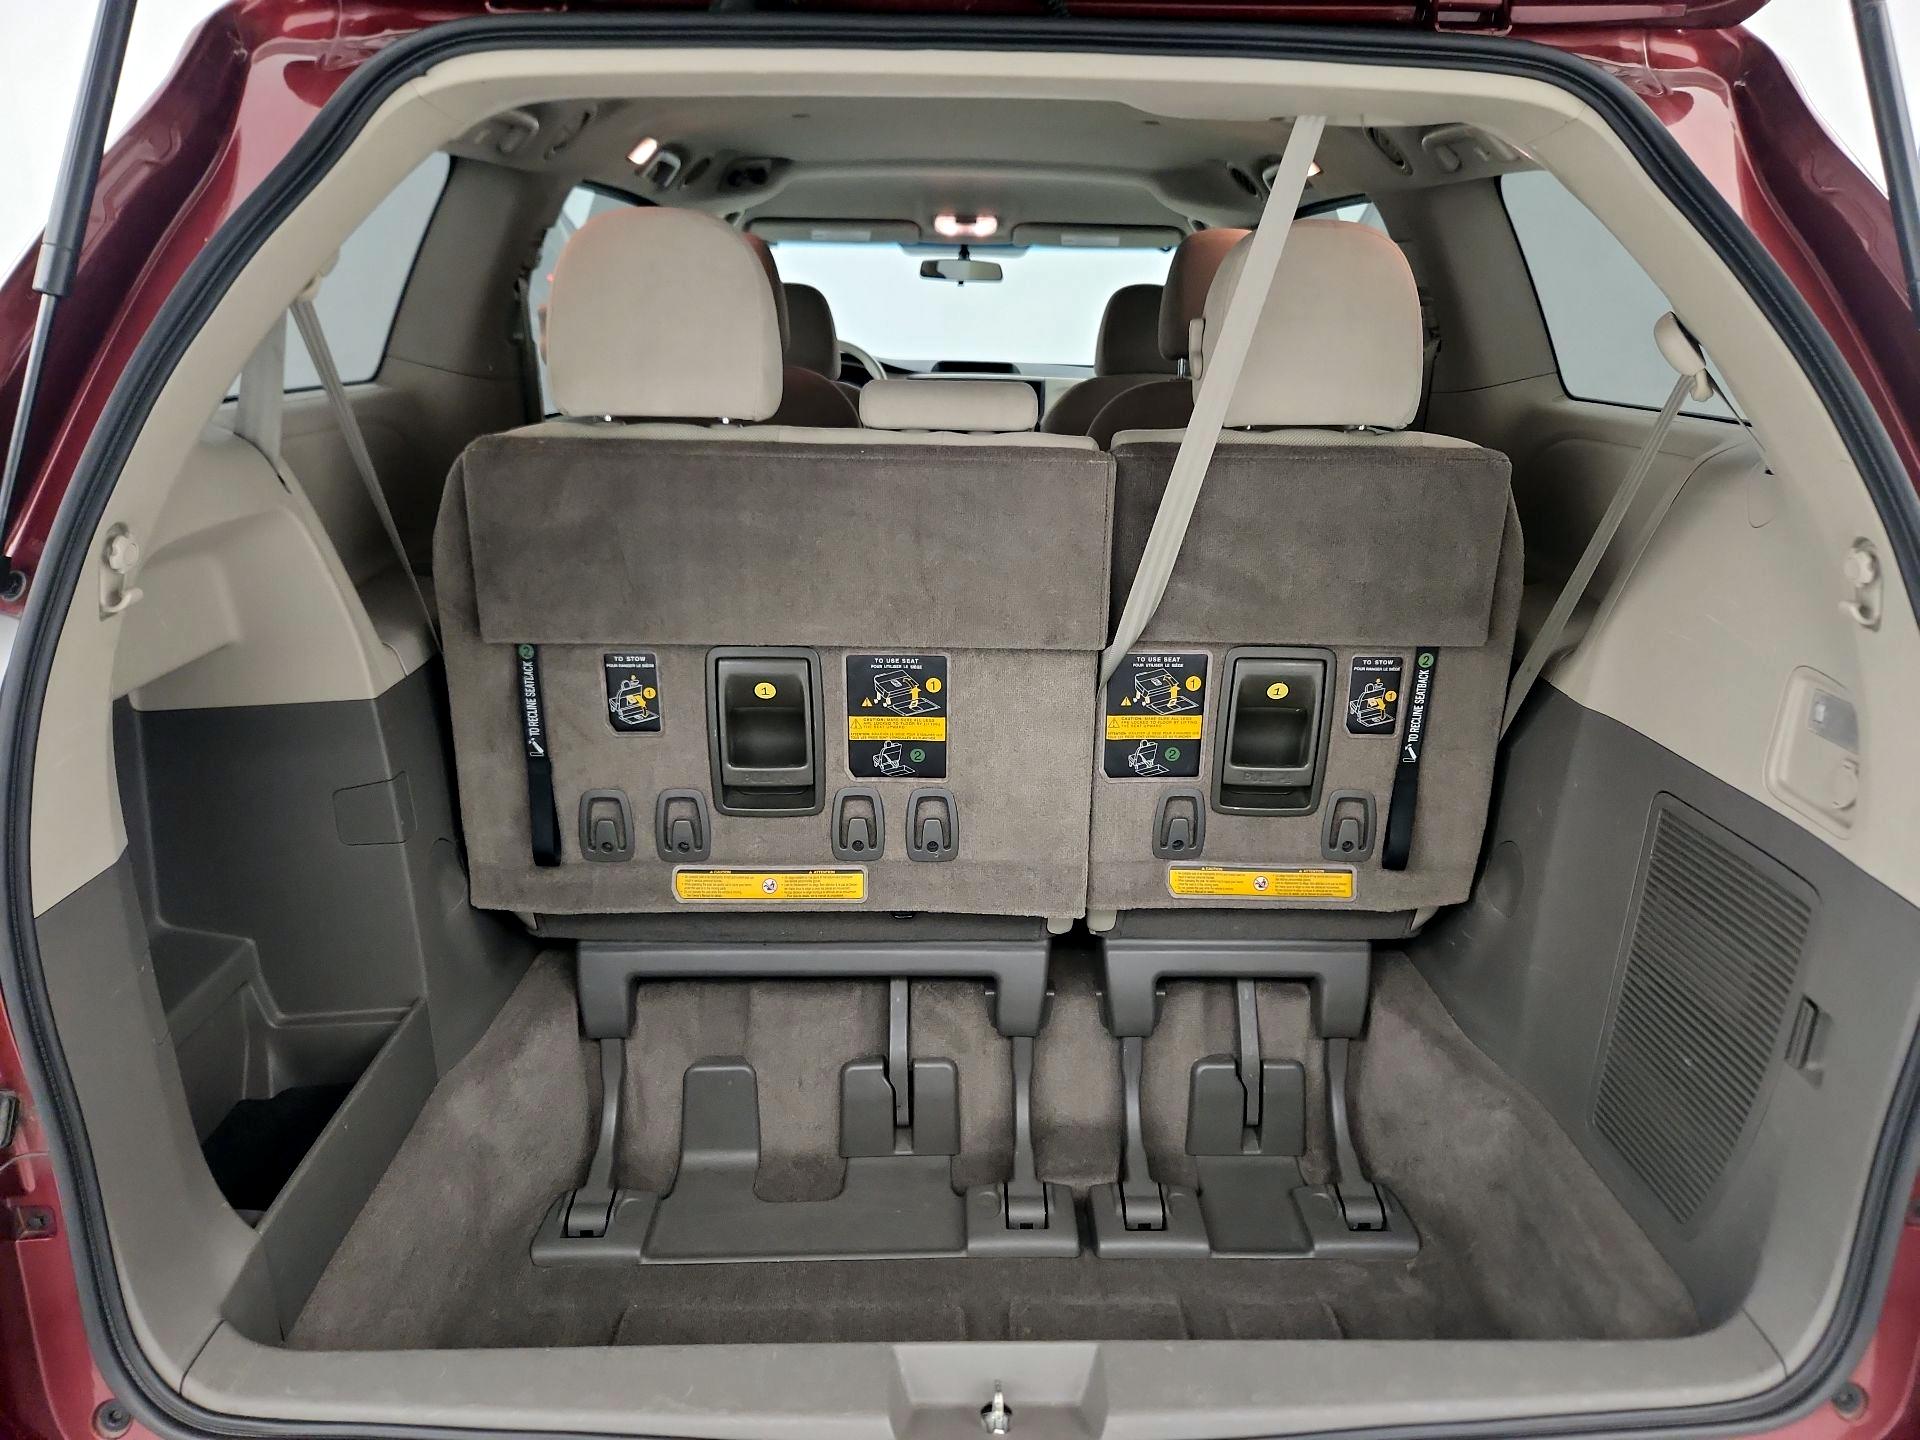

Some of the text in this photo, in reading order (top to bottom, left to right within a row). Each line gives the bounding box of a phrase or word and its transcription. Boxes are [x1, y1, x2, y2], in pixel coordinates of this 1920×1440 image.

[1422, 656, 1429, 666] 2
[522, 660, 540, 736] TO RECLINE SEATBACK
[761, 687, 770, 695] 1
[1408, 670, 1430, 742] TO RECLINE SEATBACK
